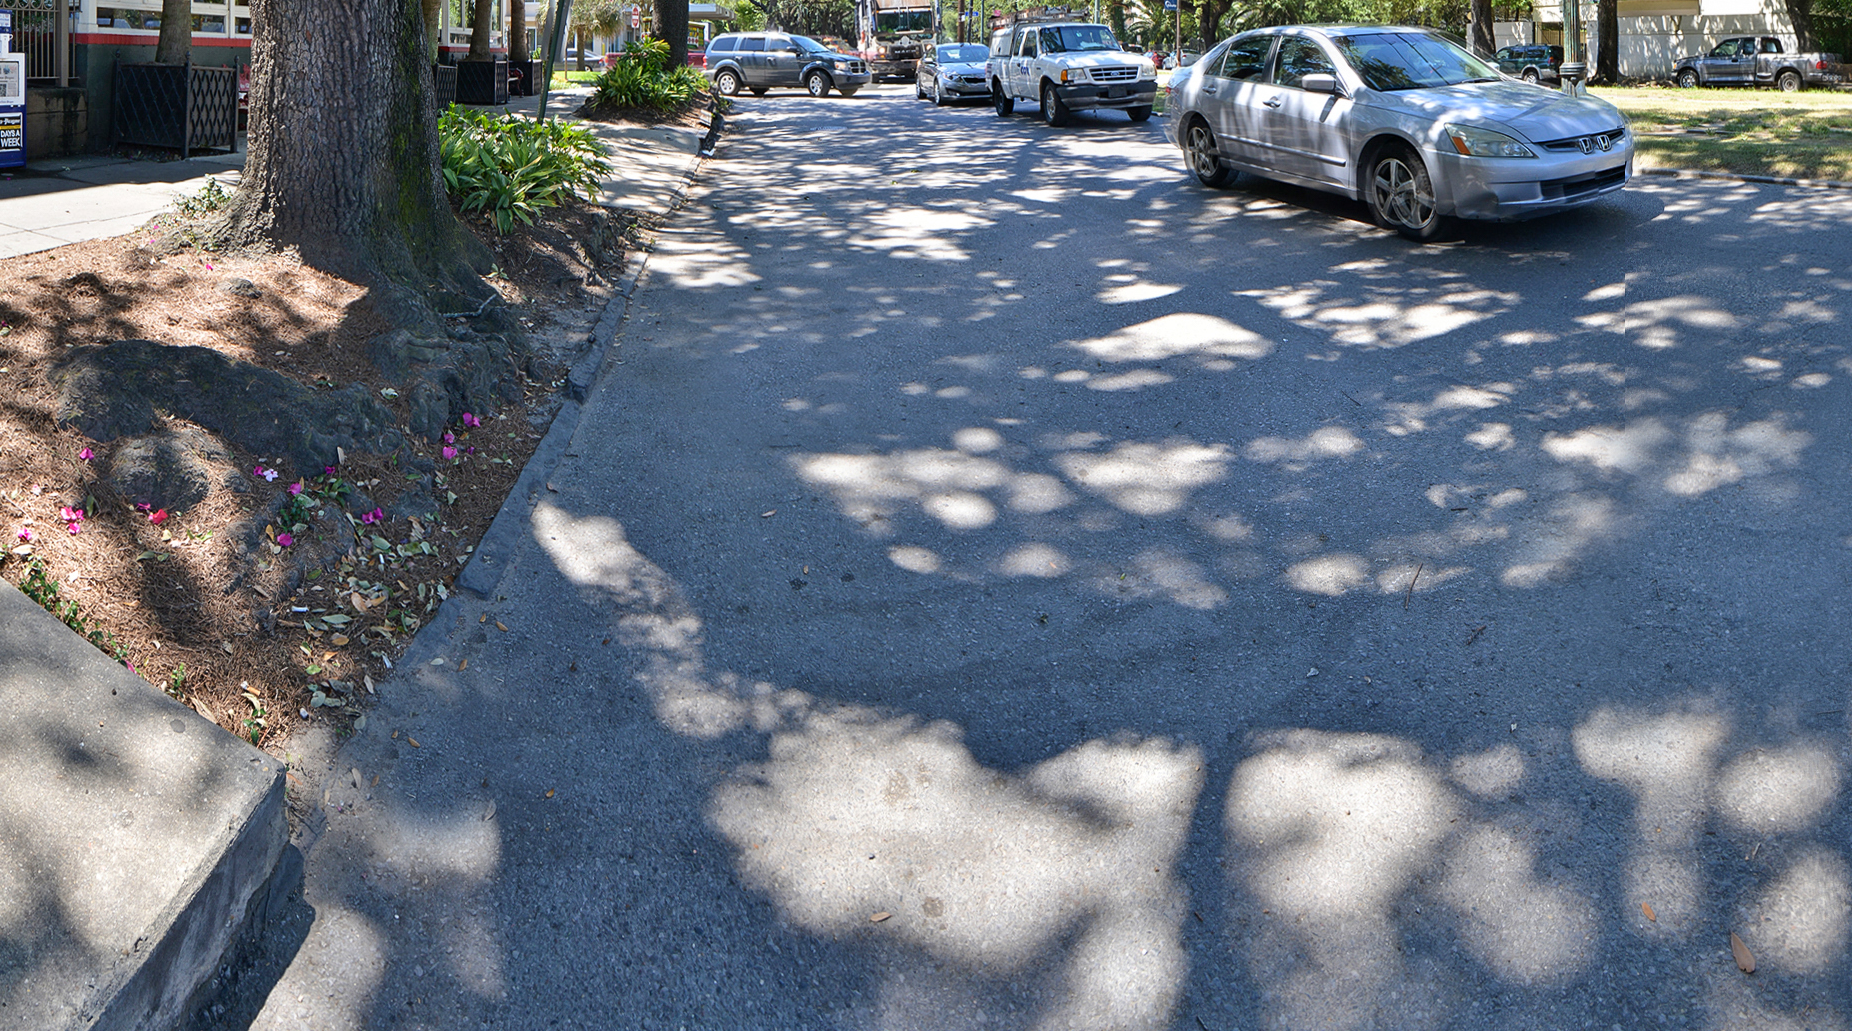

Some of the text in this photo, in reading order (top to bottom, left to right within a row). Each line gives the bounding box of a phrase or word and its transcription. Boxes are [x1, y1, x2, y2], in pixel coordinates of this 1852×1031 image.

[0, 129, 21, 138] DAYS A
[0, 137, 21, 147] WEEK
